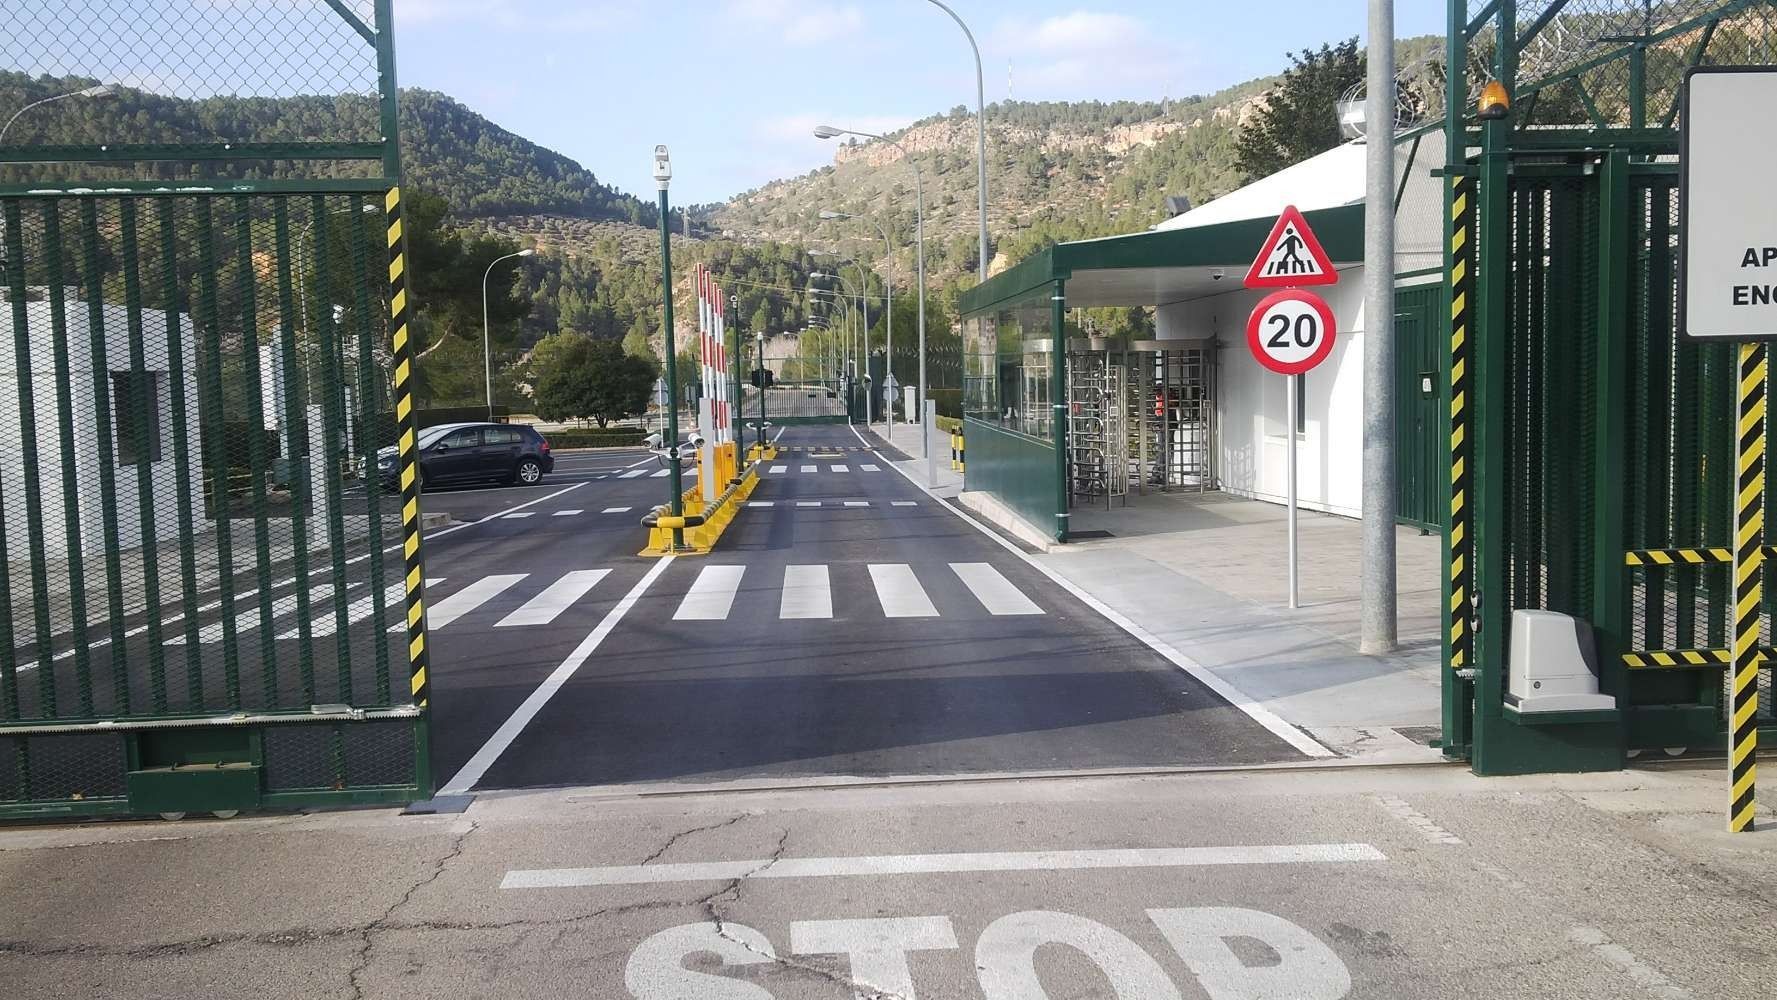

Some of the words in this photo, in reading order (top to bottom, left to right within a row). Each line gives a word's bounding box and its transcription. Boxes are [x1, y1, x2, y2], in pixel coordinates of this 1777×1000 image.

[1733, 285, 1777, 306] EN
[1267, 314, 1317, 348] 20
[624, 906, 1352, 1000] STOP
